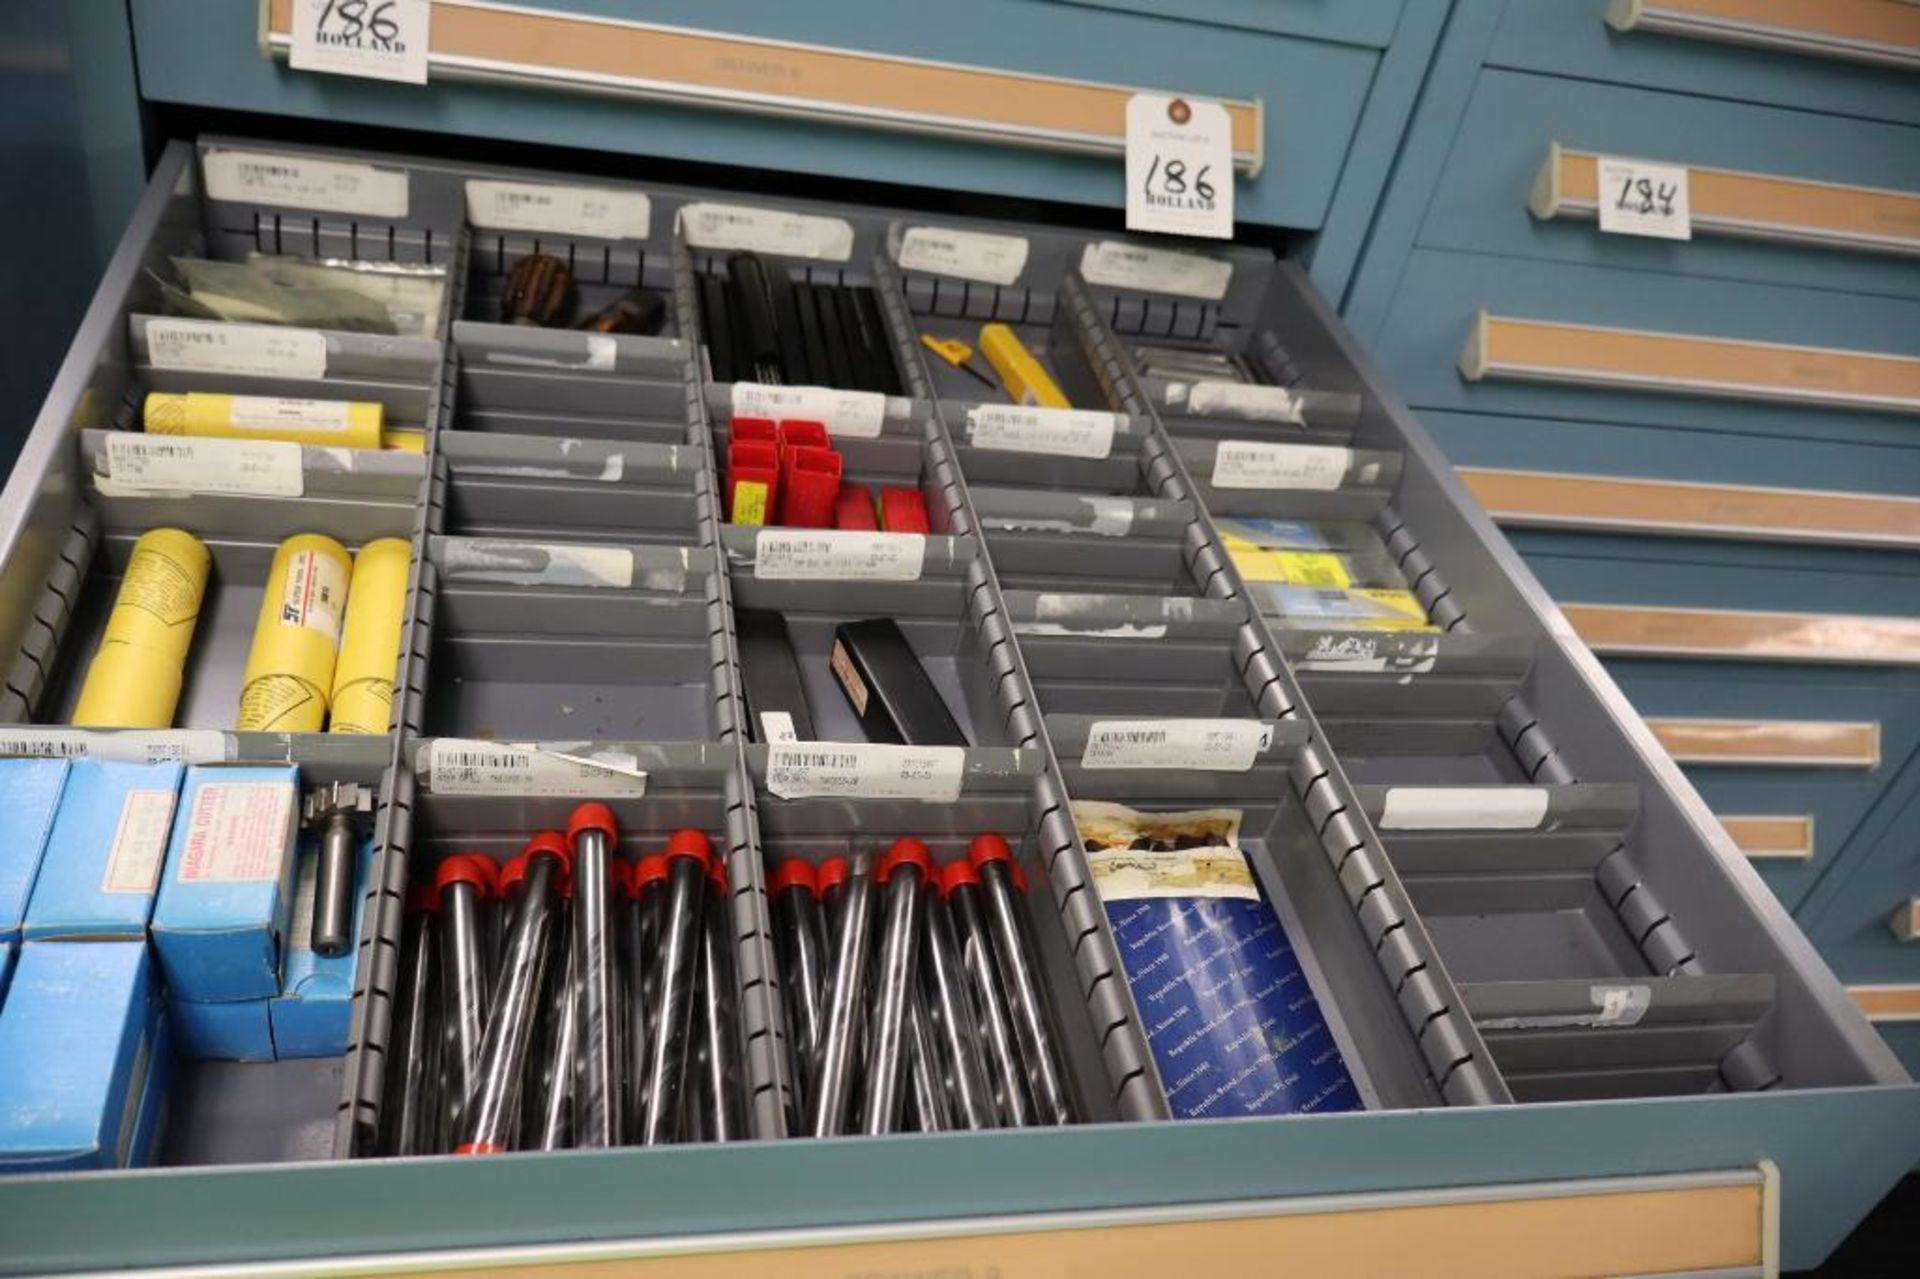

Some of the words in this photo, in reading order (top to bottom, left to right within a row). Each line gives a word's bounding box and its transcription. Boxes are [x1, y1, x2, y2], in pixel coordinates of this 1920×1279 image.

[317, 0, 399, 41] 186
[316, 31, 405, 53] HOLLAND
[1144, 154, 1215, 201] 186
[1145, 193, 1215, 211] HOLLAND
[1618, 179, 1677, 216] 184
